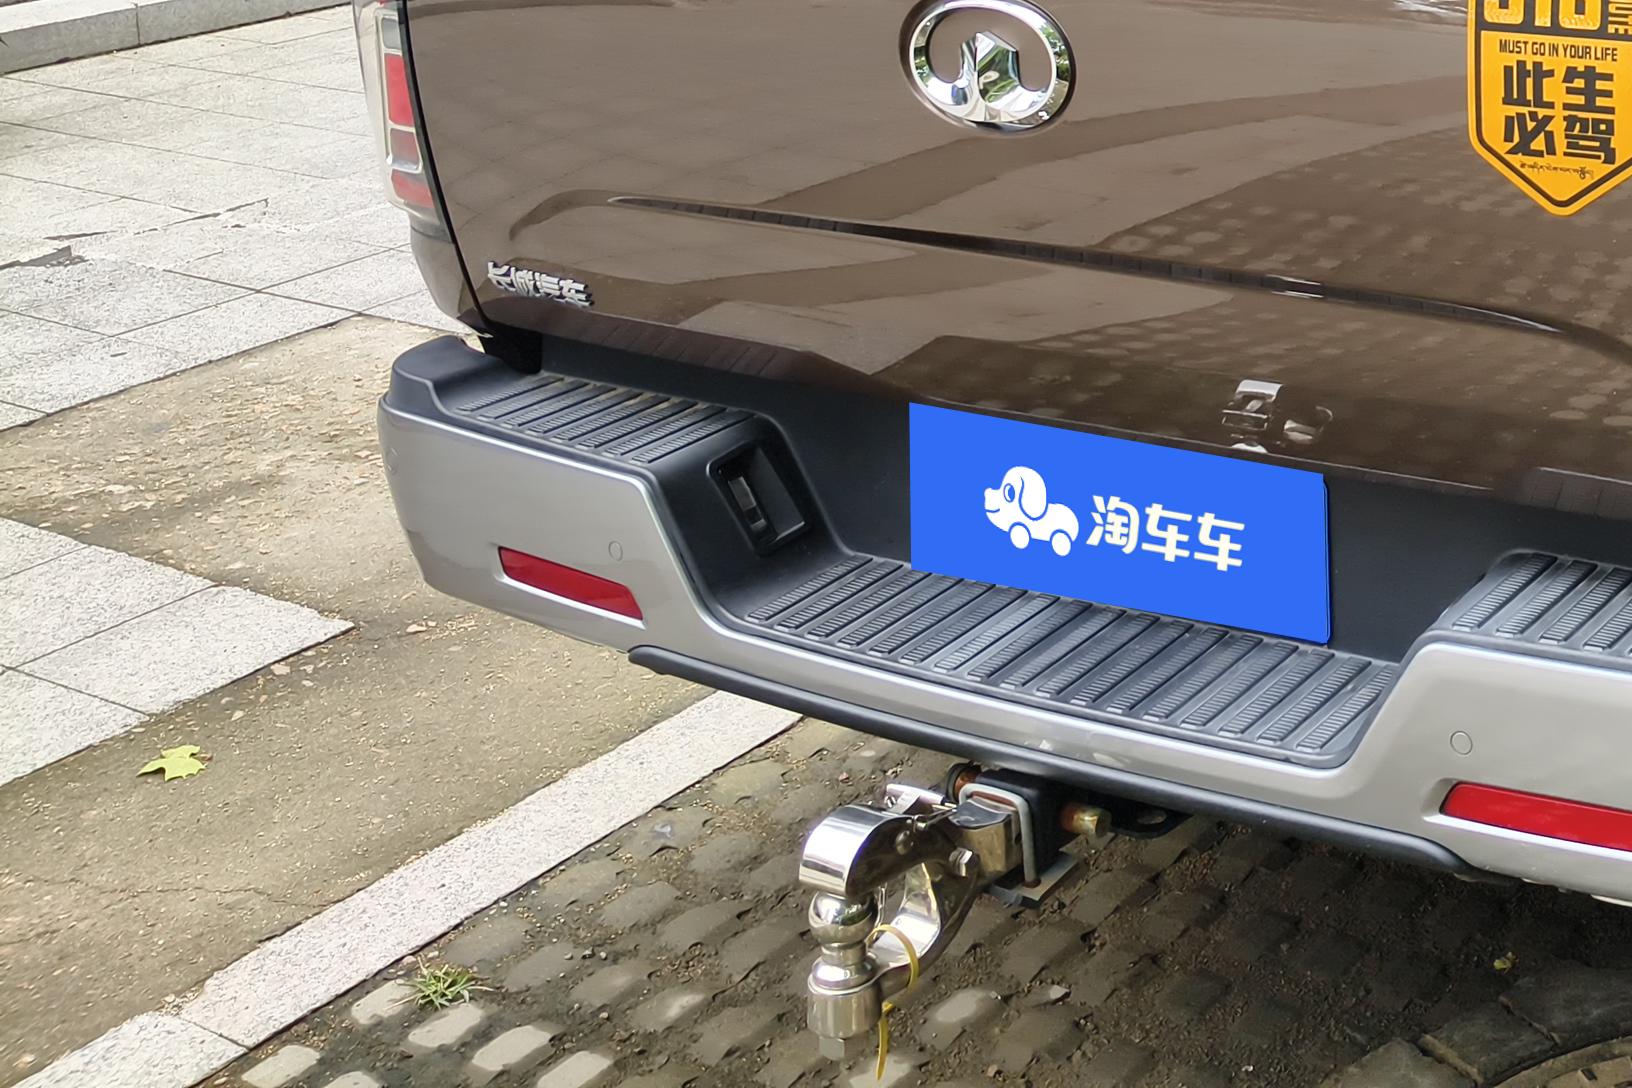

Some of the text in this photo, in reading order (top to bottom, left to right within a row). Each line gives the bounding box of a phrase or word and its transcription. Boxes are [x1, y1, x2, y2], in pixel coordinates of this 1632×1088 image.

[1499, 39, 1618, 62] MUST GO IN YOUR LIFE
[1501, 60, 1615, 114] 此生
[1503, 110, 1616, 165] 必驾
[487, 261, 592, 309] 长城汽车
